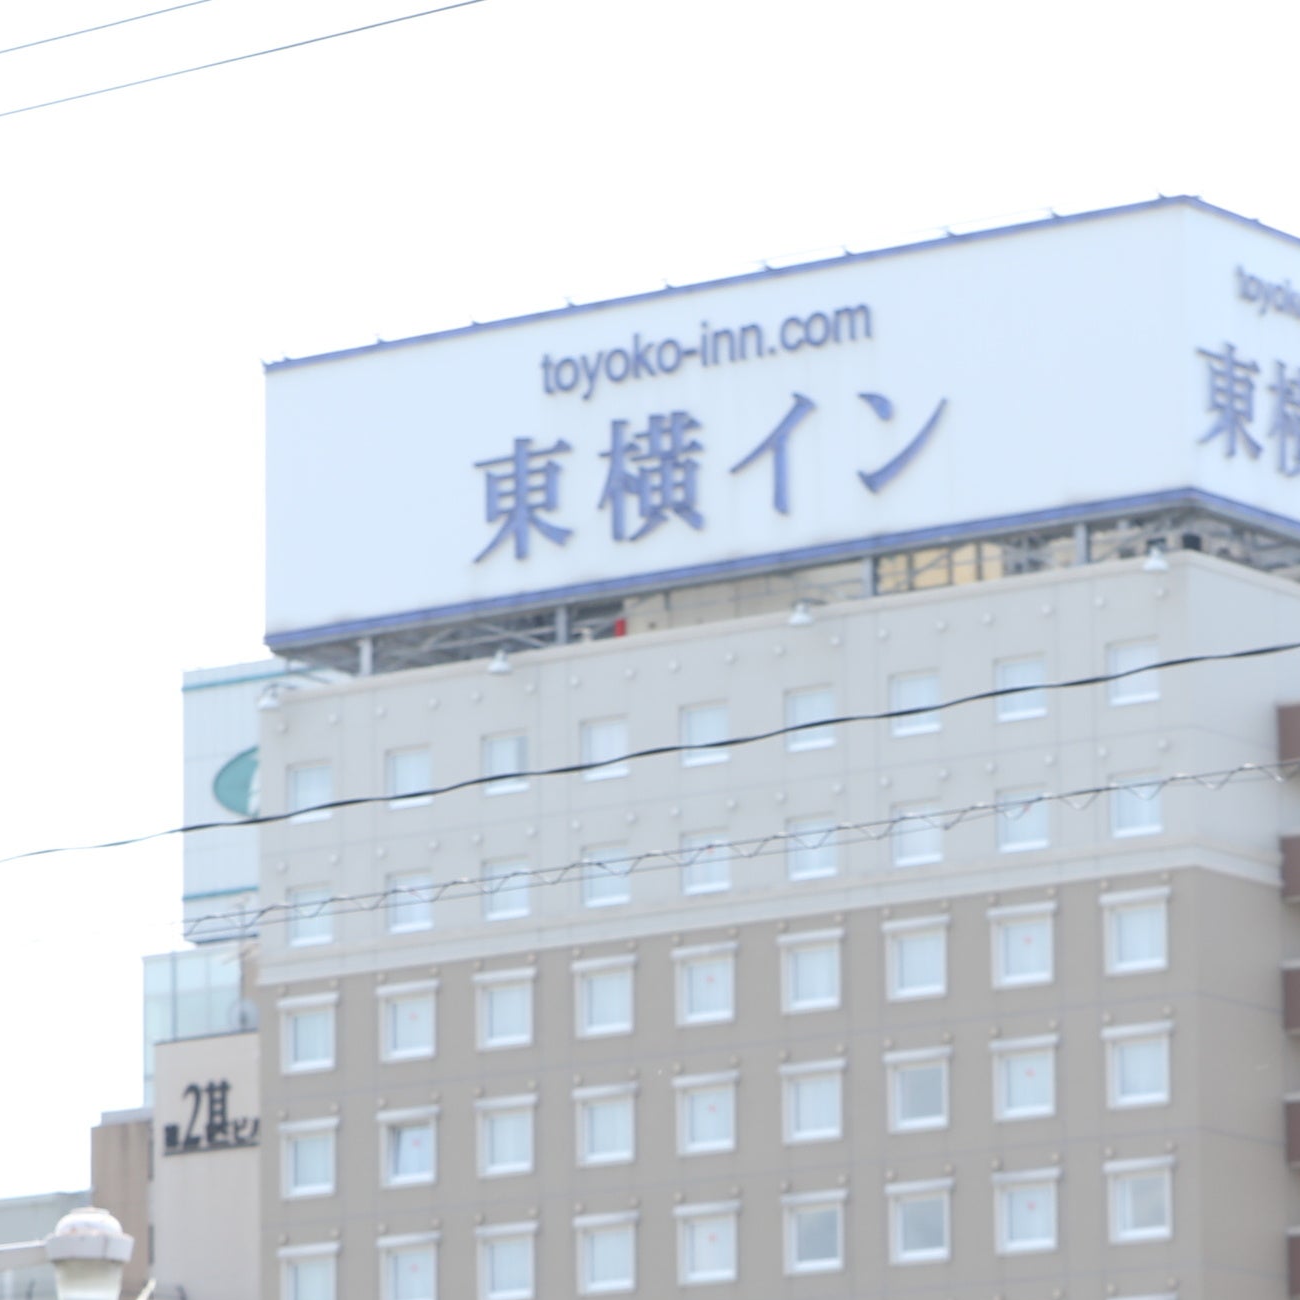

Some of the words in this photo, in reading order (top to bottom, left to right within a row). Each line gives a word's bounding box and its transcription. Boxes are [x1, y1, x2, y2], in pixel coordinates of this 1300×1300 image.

[540, 302, 873, 401] toyoko-inn.com
[474, 392, 948, 563] 東横イン
